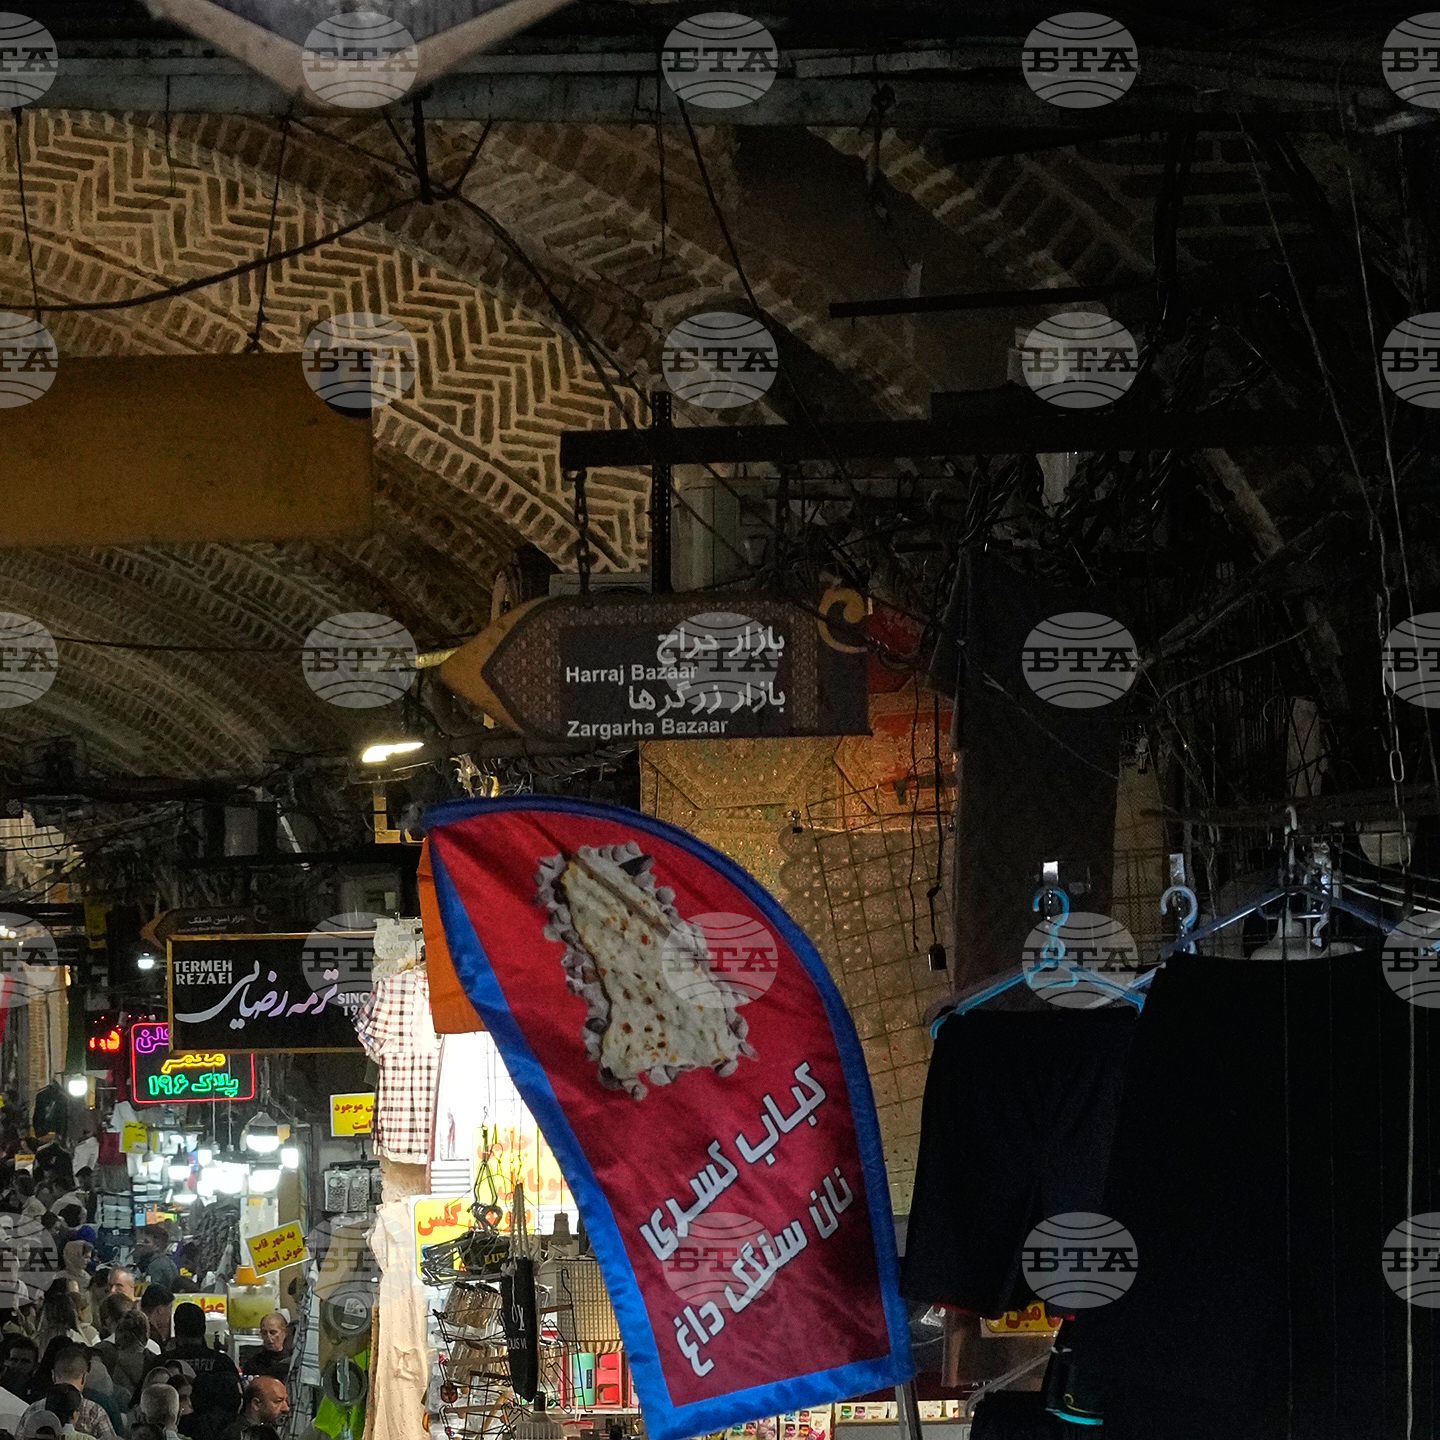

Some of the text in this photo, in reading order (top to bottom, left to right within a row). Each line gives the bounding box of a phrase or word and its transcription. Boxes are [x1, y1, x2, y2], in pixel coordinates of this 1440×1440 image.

[656, 626, 786, 663] بازار حراج
[566, 662, 699, 685] Harraj Bazaar
[628, 682, 786, 718] بازار زرگرها
[567, 717, 729, 741] Zargarha Bazaar
[174, 960, 233, 973] TERMEH
[176, 972, 233, 986] REZAEI
[287, 968, 340, 1017] ترمه
[148, 1072, 239, 1097] پلاک ۱۹۶
[735, 1060, 828, 1166] کباب
[639, 1139, 739, 1262] کسری
[808, 1165, 855, 1241] نان
[257, 1245, 303, 1269] خوش آمدید
[674, 1298, 725, 1378] داغ
